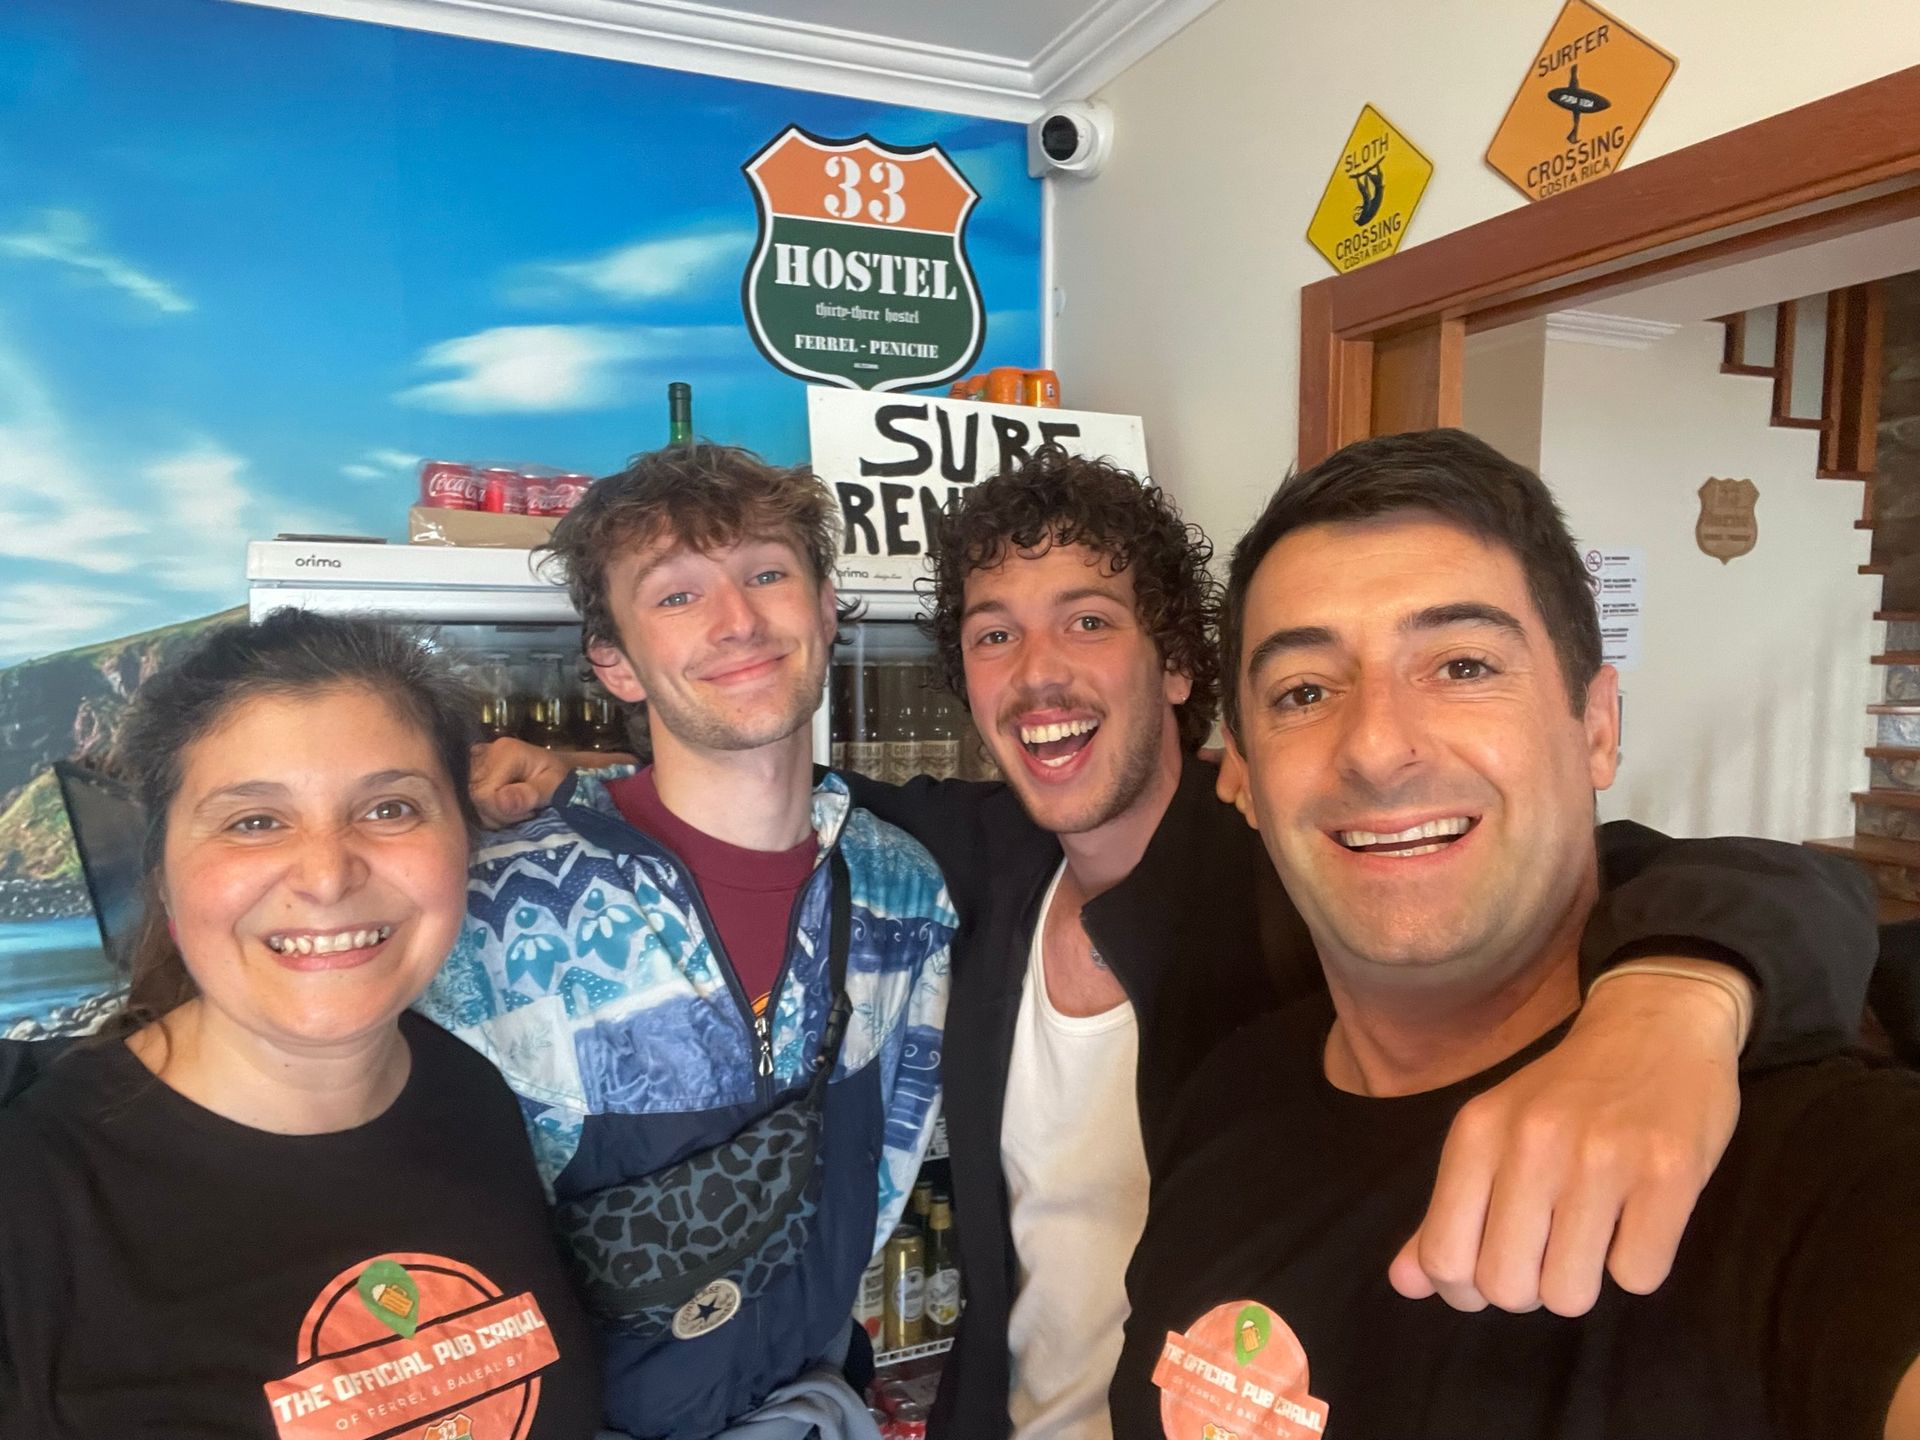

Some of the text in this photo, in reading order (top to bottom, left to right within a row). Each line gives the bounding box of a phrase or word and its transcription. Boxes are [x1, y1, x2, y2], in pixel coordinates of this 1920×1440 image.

[1538, 25, 1609, 77] SURFER
[1345, 133, 1389, 173] SLOTH
[1527, 126, 1625, 188] CROSSING
[1539, 157, 1611, 198] COSTA RICA
[823, 156, 906, 224] 33
[1335, 212, 1402, 260] CROSSING
[1344, 238, 1392, 270] COSTA RICA
[774, 243, 957, 300] HOSTEL
[815, 302, 920, 324] thirty-three hostel
[795, 334, 858, 353] FERREL
[869, 340, 940, 359] PENICHE
[835, 482, 976, 556] REN
[295, 554, 341, 568] orima
[272, 1309, 545, 1424] THE OFFICIAL PUB CRAWL
[336, 1414, 360, 1431] OF
[367, 1391, 427, 1419] FERREL
[447, 1363, 502, 1390] BALEAL
[506, 1352, 523, 1367] BY
[1163, 1342, 1185, 1366] THE
[1183, 1353, 1238, 1394] OFFICIAL
[1241, 1380, 1274, 1409] PUB
[1273, 1396, 1323, 1435] CRAWL
